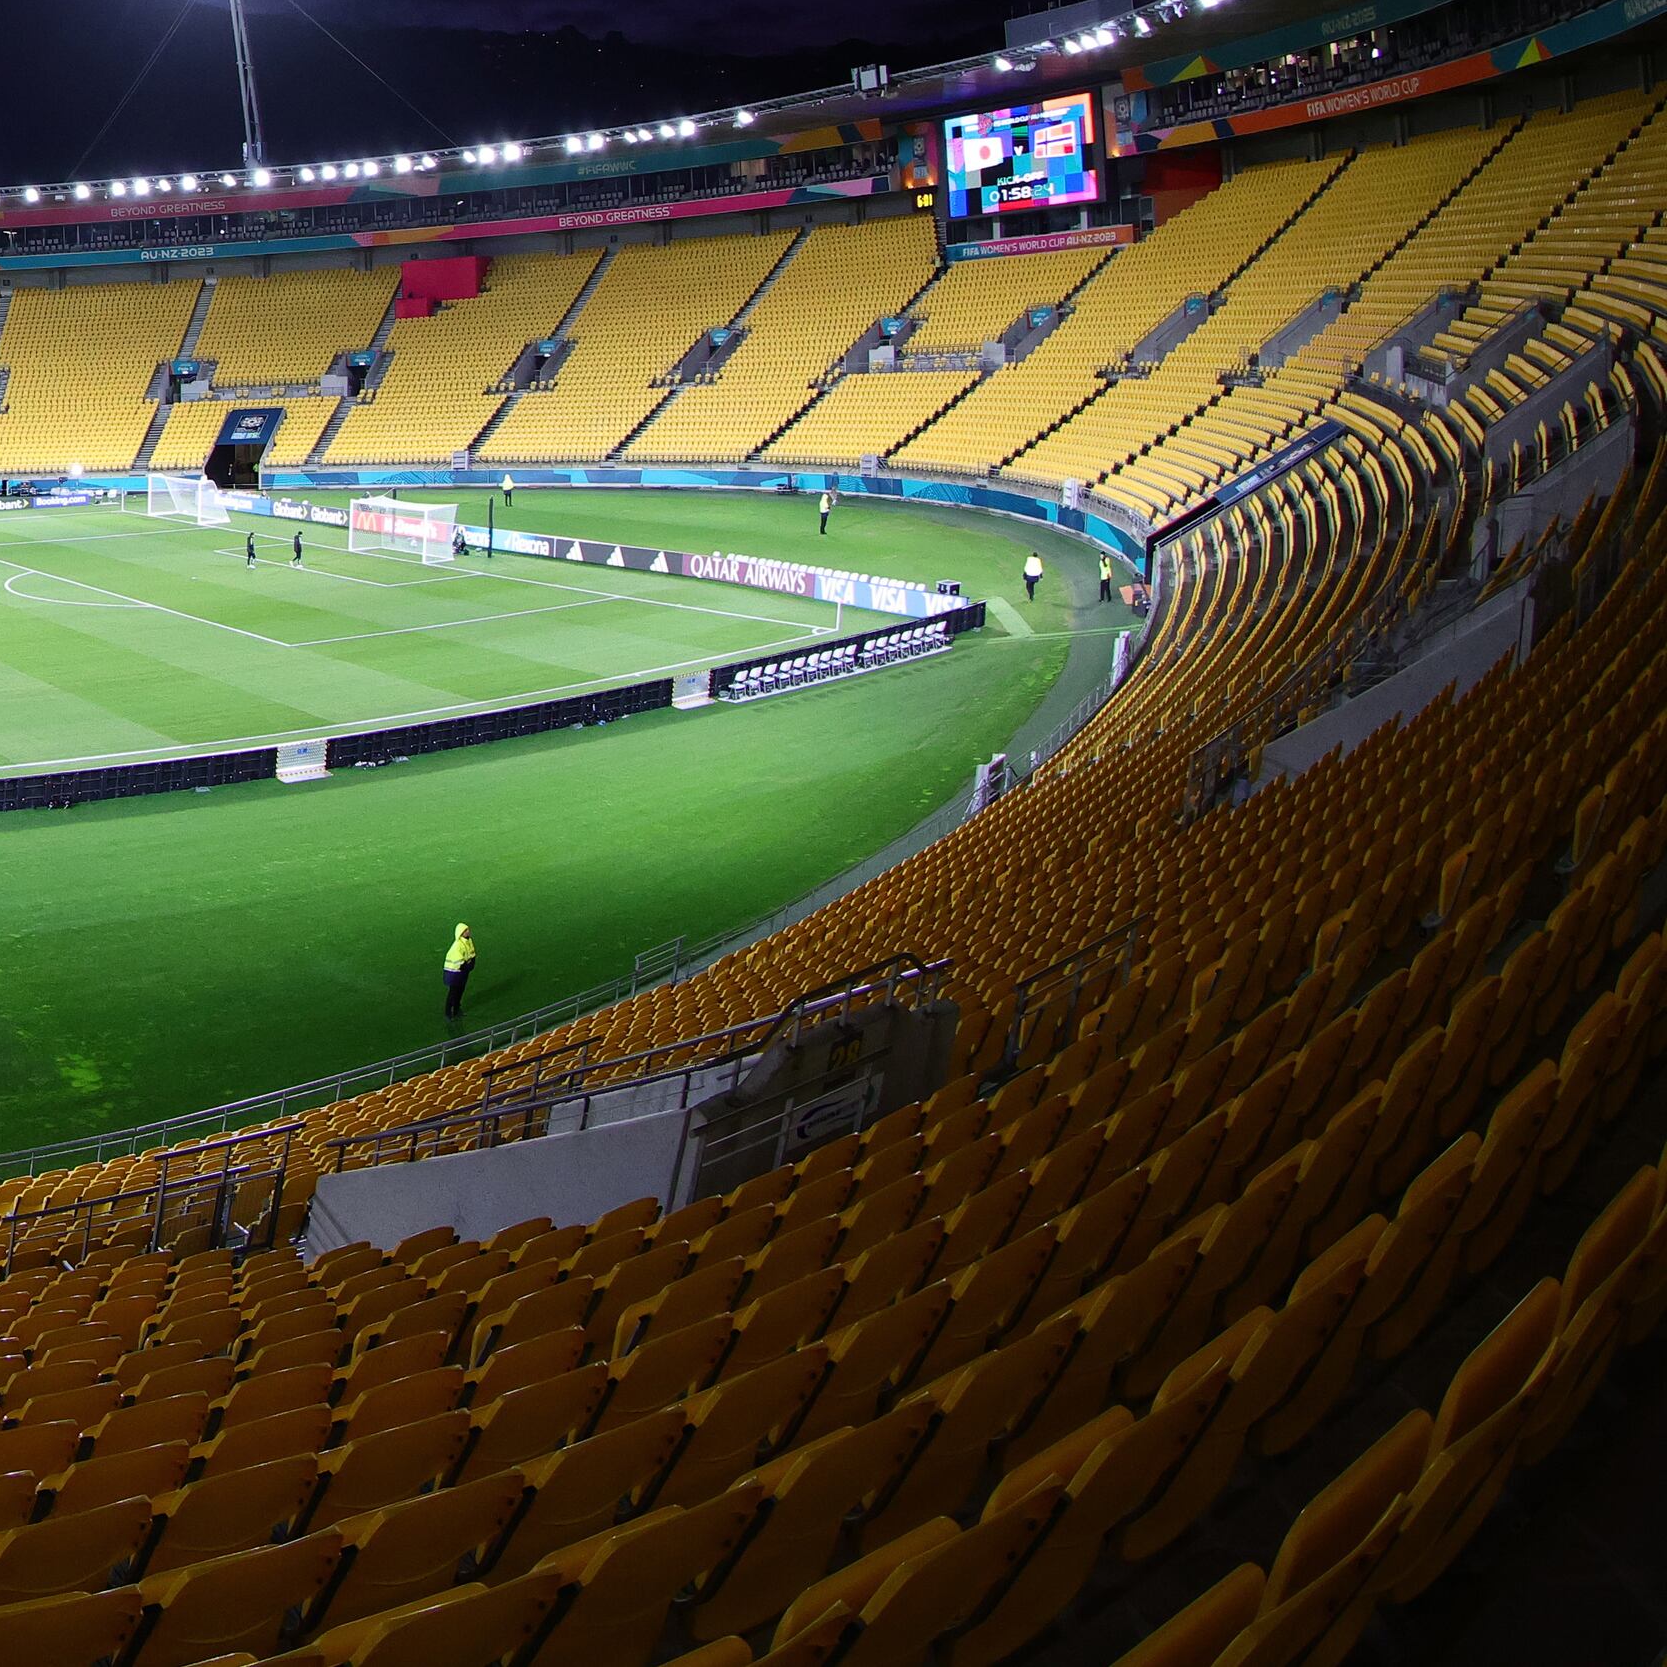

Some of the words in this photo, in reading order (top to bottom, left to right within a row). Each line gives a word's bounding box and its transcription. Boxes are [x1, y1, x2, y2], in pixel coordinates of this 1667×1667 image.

[1307, 103, 1327, 118] FIFA
[1325, 89, 1370, 112] WOMEN'S
[1370, 82, 1400, 102] WORLD
[1402, 77, 1420, 94] CUP
[989, 183, 1055, 202] 01:58:24
[110, 205, 156, 217] BEYOND
[558, 214, 604, 227] BEYOND
[963, 246, 979, 256] FIFA
[981, 242, 1018, 255] WOMEN'S
[1019, 240, 1047, 250] WORLD
[1049, 237, 1065, 247] CUP
[512, 533, 550, 556] Rexona
[690, 555, 740, 582] QATAR
[744, 564, 806, 594] AIRWAYS
[819, 575, 855, 605] VISA
[869, 584, 908, 614] VISA
